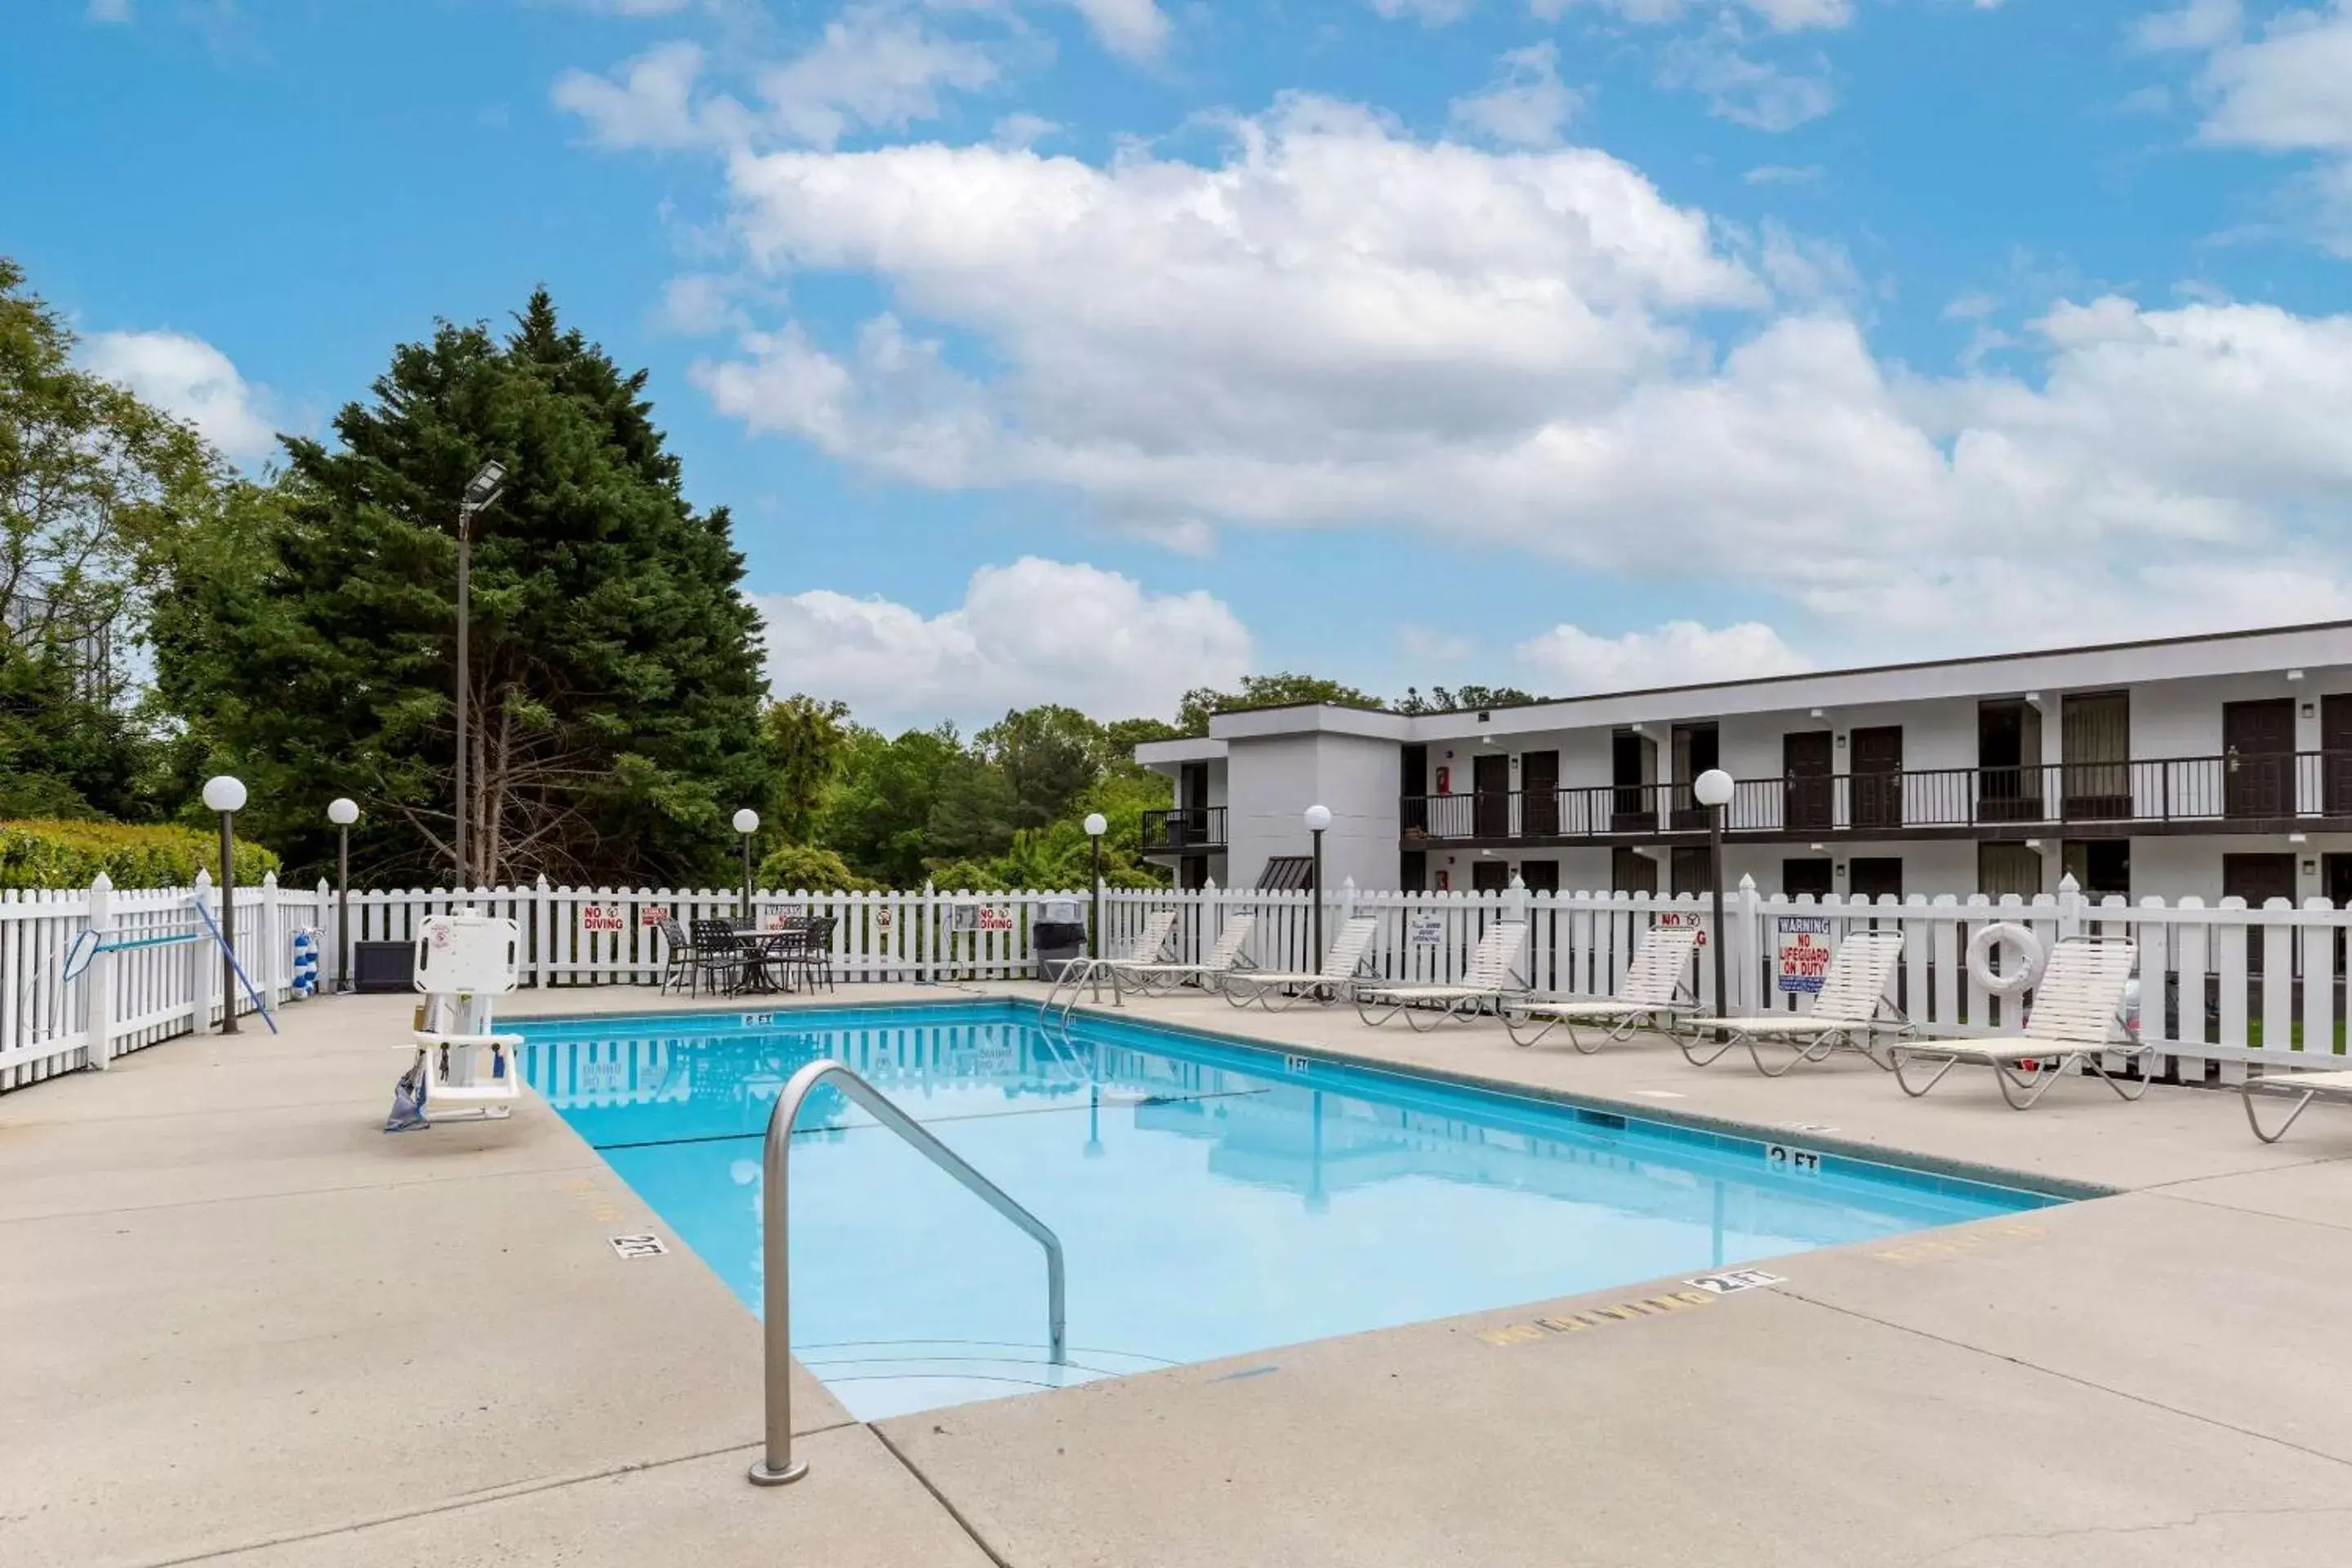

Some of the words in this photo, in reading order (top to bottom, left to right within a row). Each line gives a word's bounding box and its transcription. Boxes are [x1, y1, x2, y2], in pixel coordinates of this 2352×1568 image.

[584, 907, 601, 918] NO
[981, 909, 993, 918] NO
[584, 919, 624, 929] DIVING
[981, 920, 1012, 929] DIVING
[1662, 914, 1680, 924] NO
[1780, 920, 1829, 933] WARNING
[1798, 934, 1810, 947] NO
[1780, 948, 1829, 962] LIFEGUARD
[1784, 962, 1796, 974] ON
[1802, 963, 1824, 976] DUTY
[1795, 1152, 1817, 1169] FT
